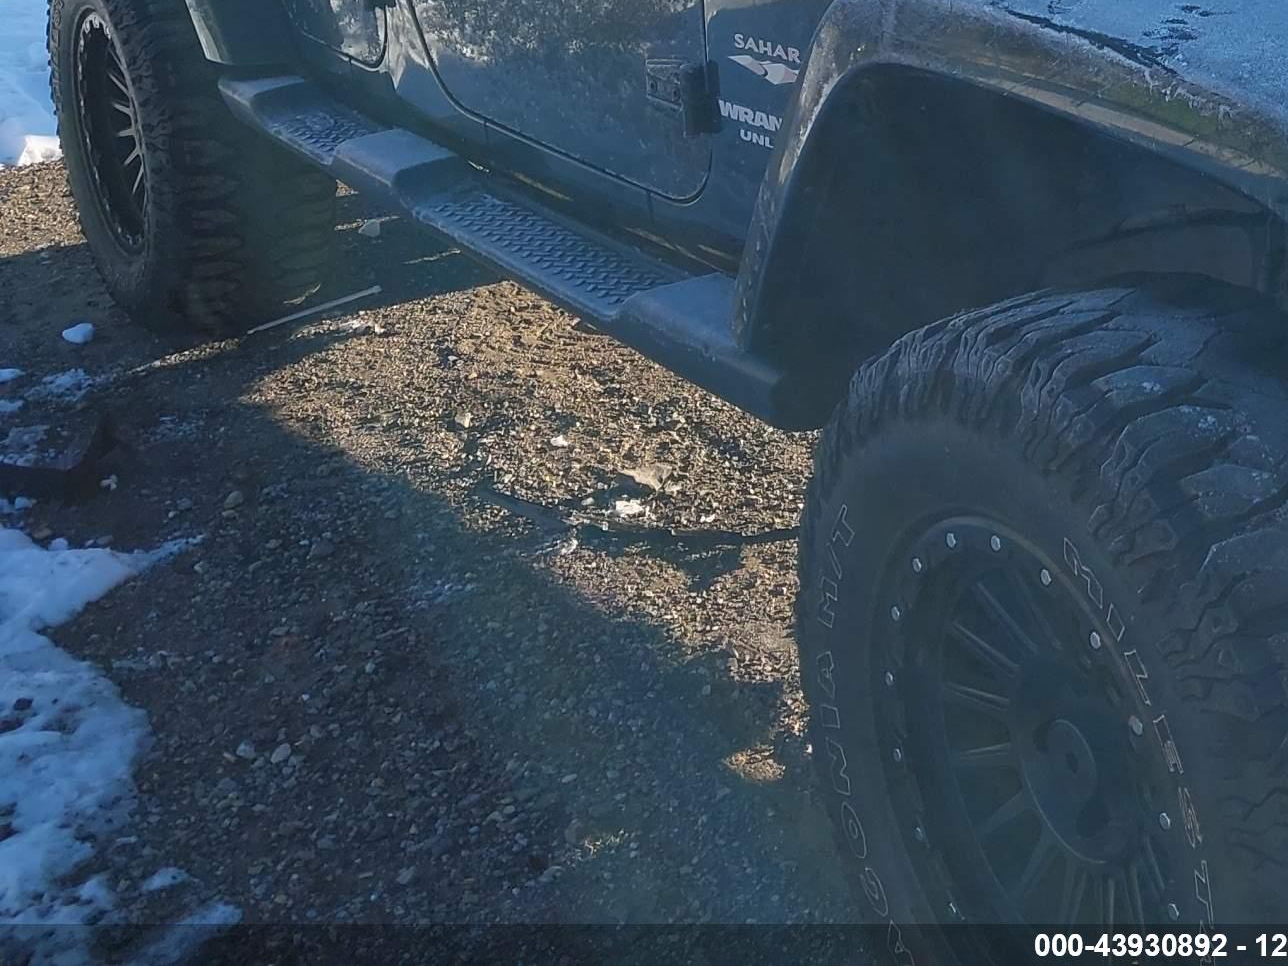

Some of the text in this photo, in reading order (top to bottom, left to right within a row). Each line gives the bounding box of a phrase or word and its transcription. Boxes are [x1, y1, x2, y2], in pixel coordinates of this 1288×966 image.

[733, 33, 800, 64] SAHAR
[718, 99, 783, 132] WRAN
[739, 129, 774, 149] UNL
